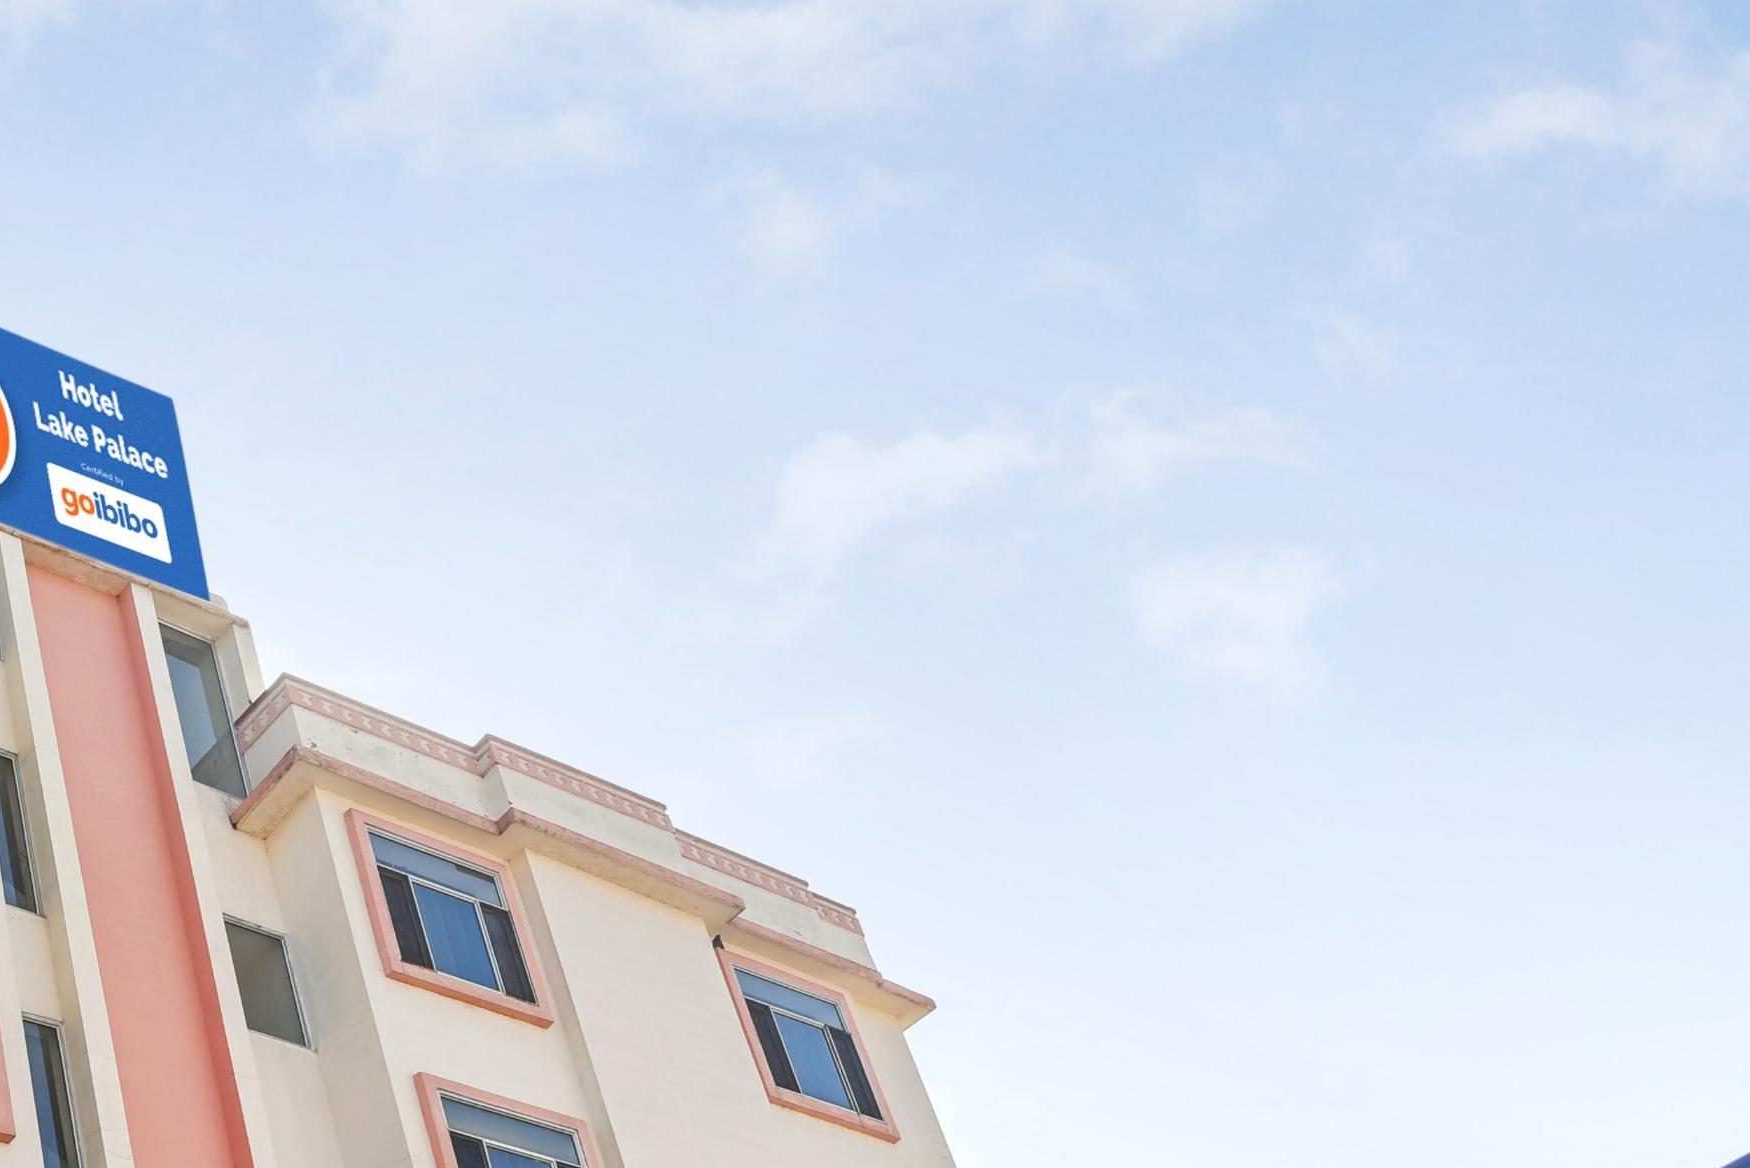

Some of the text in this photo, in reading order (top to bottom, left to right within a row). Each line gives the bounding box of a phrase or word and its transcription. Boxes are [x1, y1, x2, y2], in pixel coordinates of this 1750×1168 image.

[58, 370, 123, 421] Hotel
[33, 401, 168, 478] Lake Palace
[60, 486, 158, 539] goibibo
